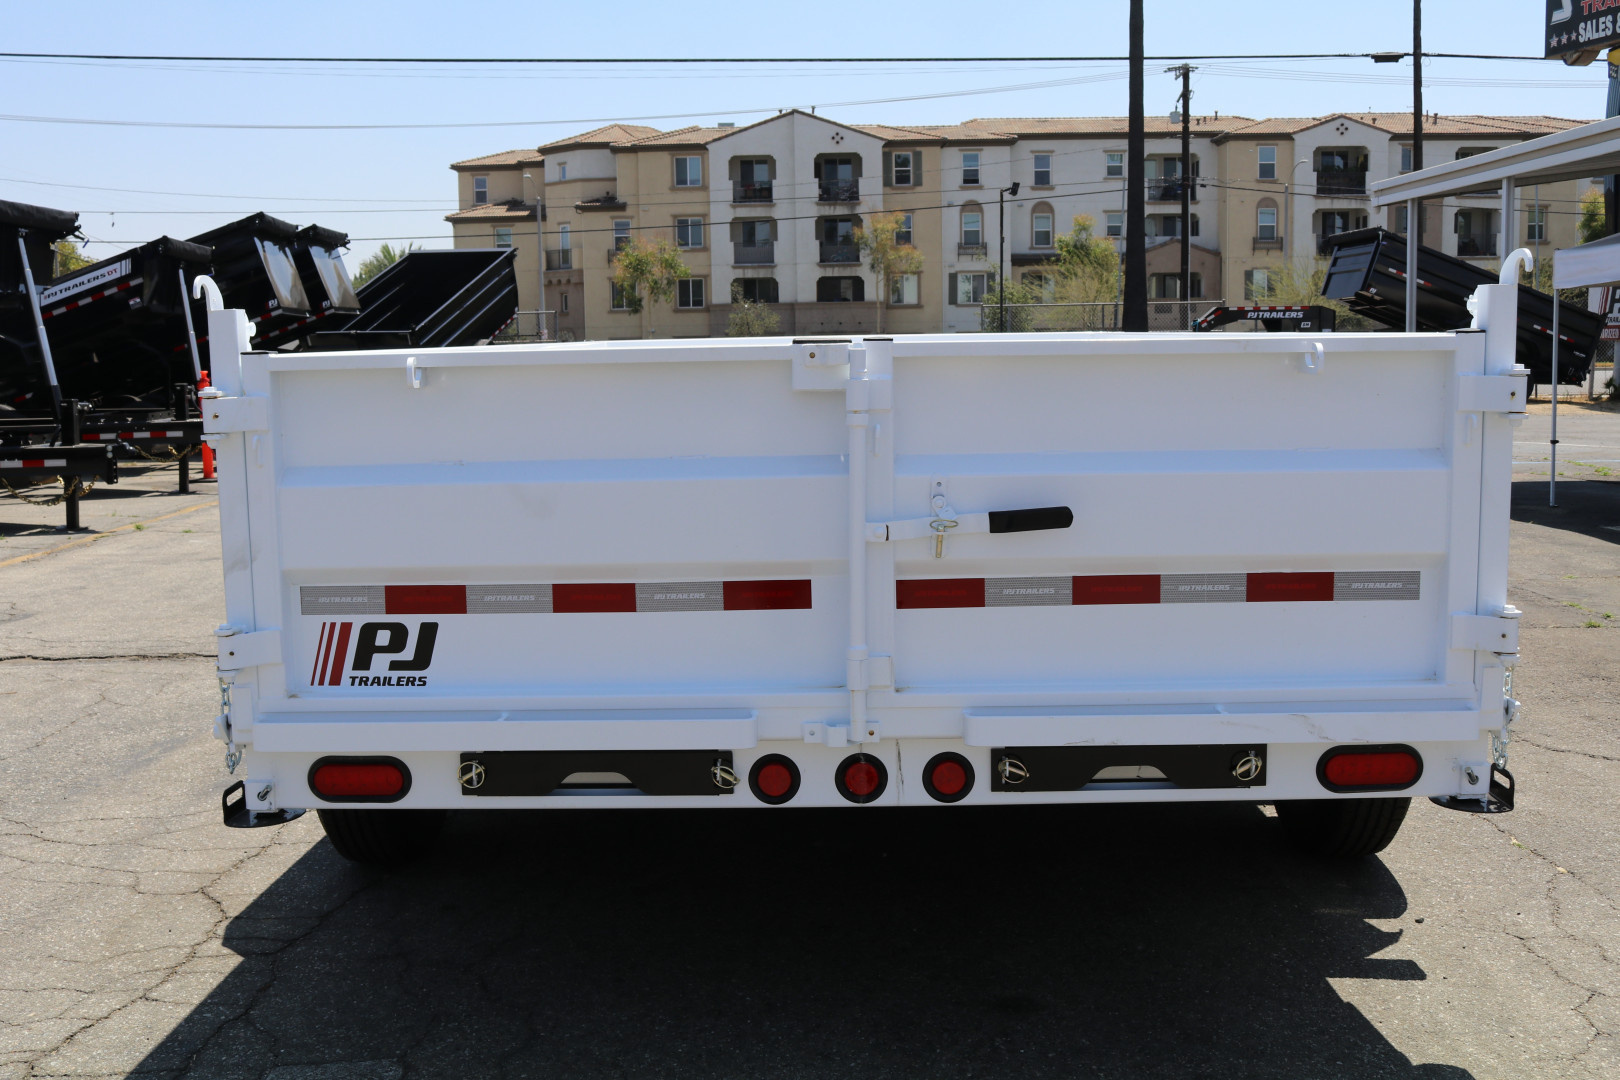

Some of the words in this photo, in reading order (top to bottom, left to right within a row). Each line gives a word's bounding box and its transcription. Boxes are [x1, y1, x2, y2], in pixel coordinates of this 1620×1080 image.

[1578, 15, 1613, 43] SALES
[352, 622, 439, 671] PJ
[350, 676, 427, 687] TRAILERS
